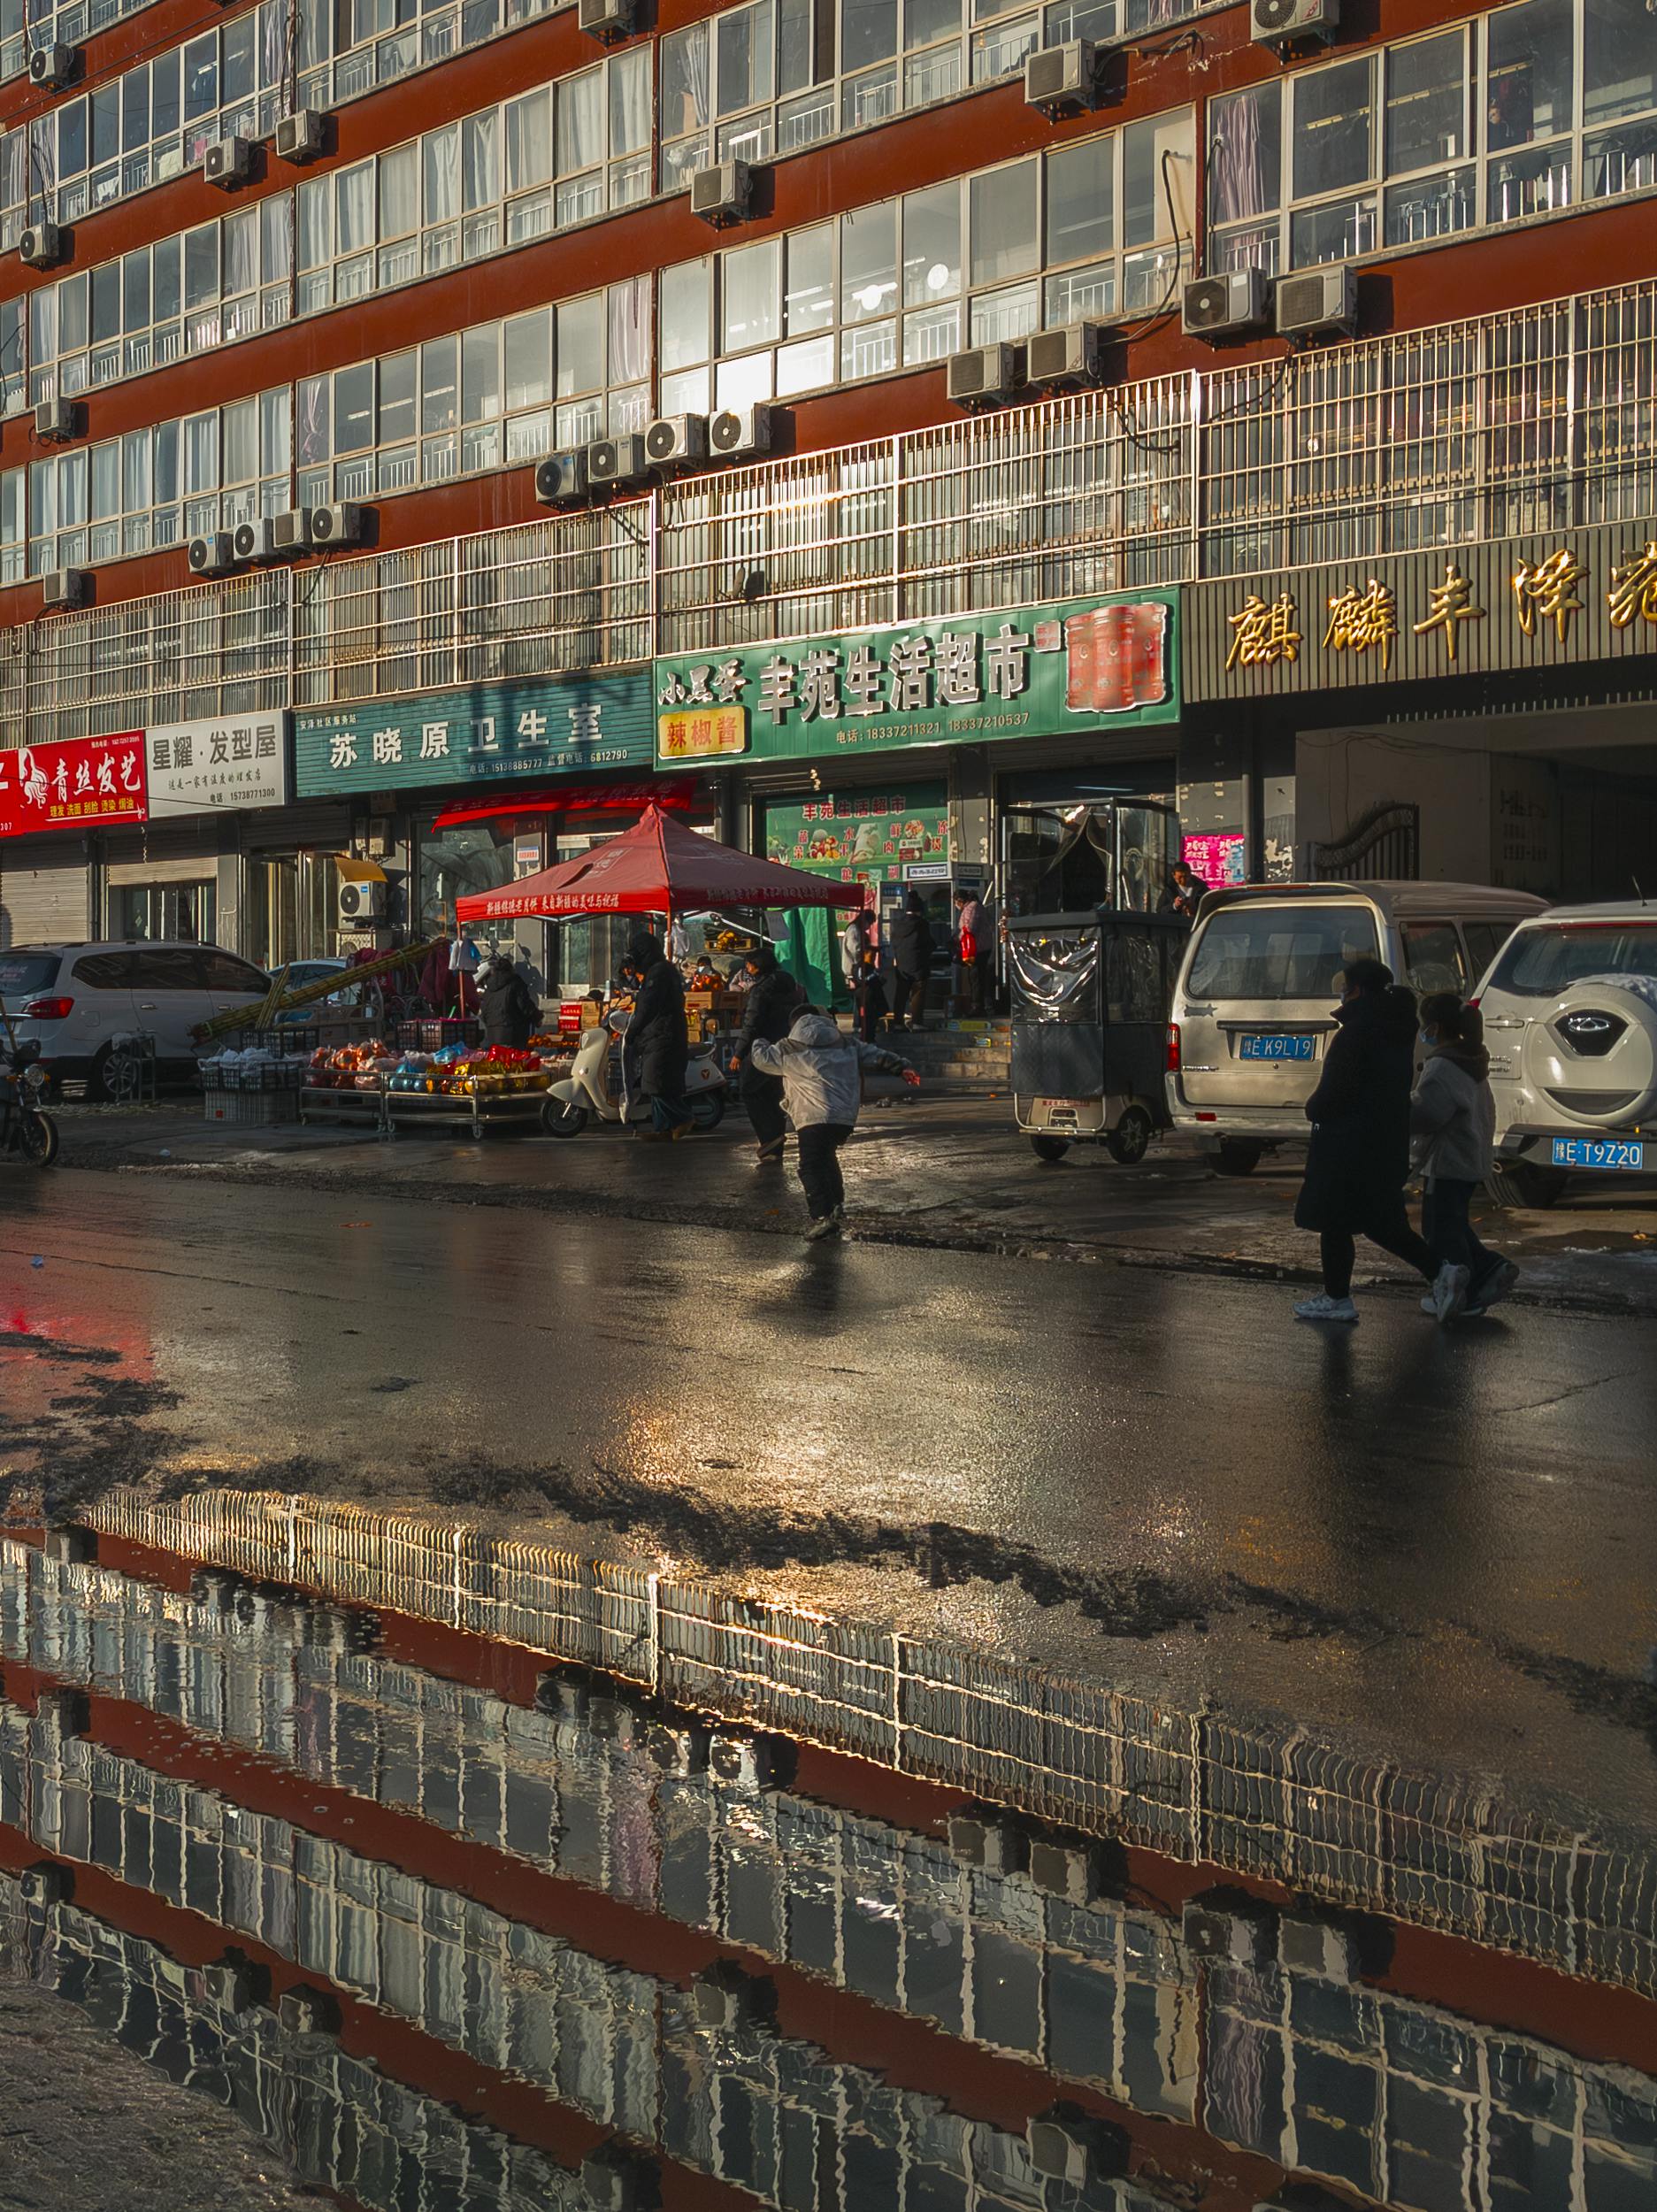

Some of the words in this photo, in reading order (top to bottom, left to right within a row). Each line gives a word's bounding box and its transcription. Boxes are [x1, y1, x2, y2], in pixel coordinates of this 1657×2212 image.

[758, 624, 1029, 725] 丰苑生活超市
[329, 703, 602, 769] 苏晓原卫生室
[667, 715, 738, 750] 辣椒酱
[51, 750, 142, 803] 青丝发艺
[230, 787, 276, 801] 15738771300
[802, 796, 907, 822] 丰苑生活超市
